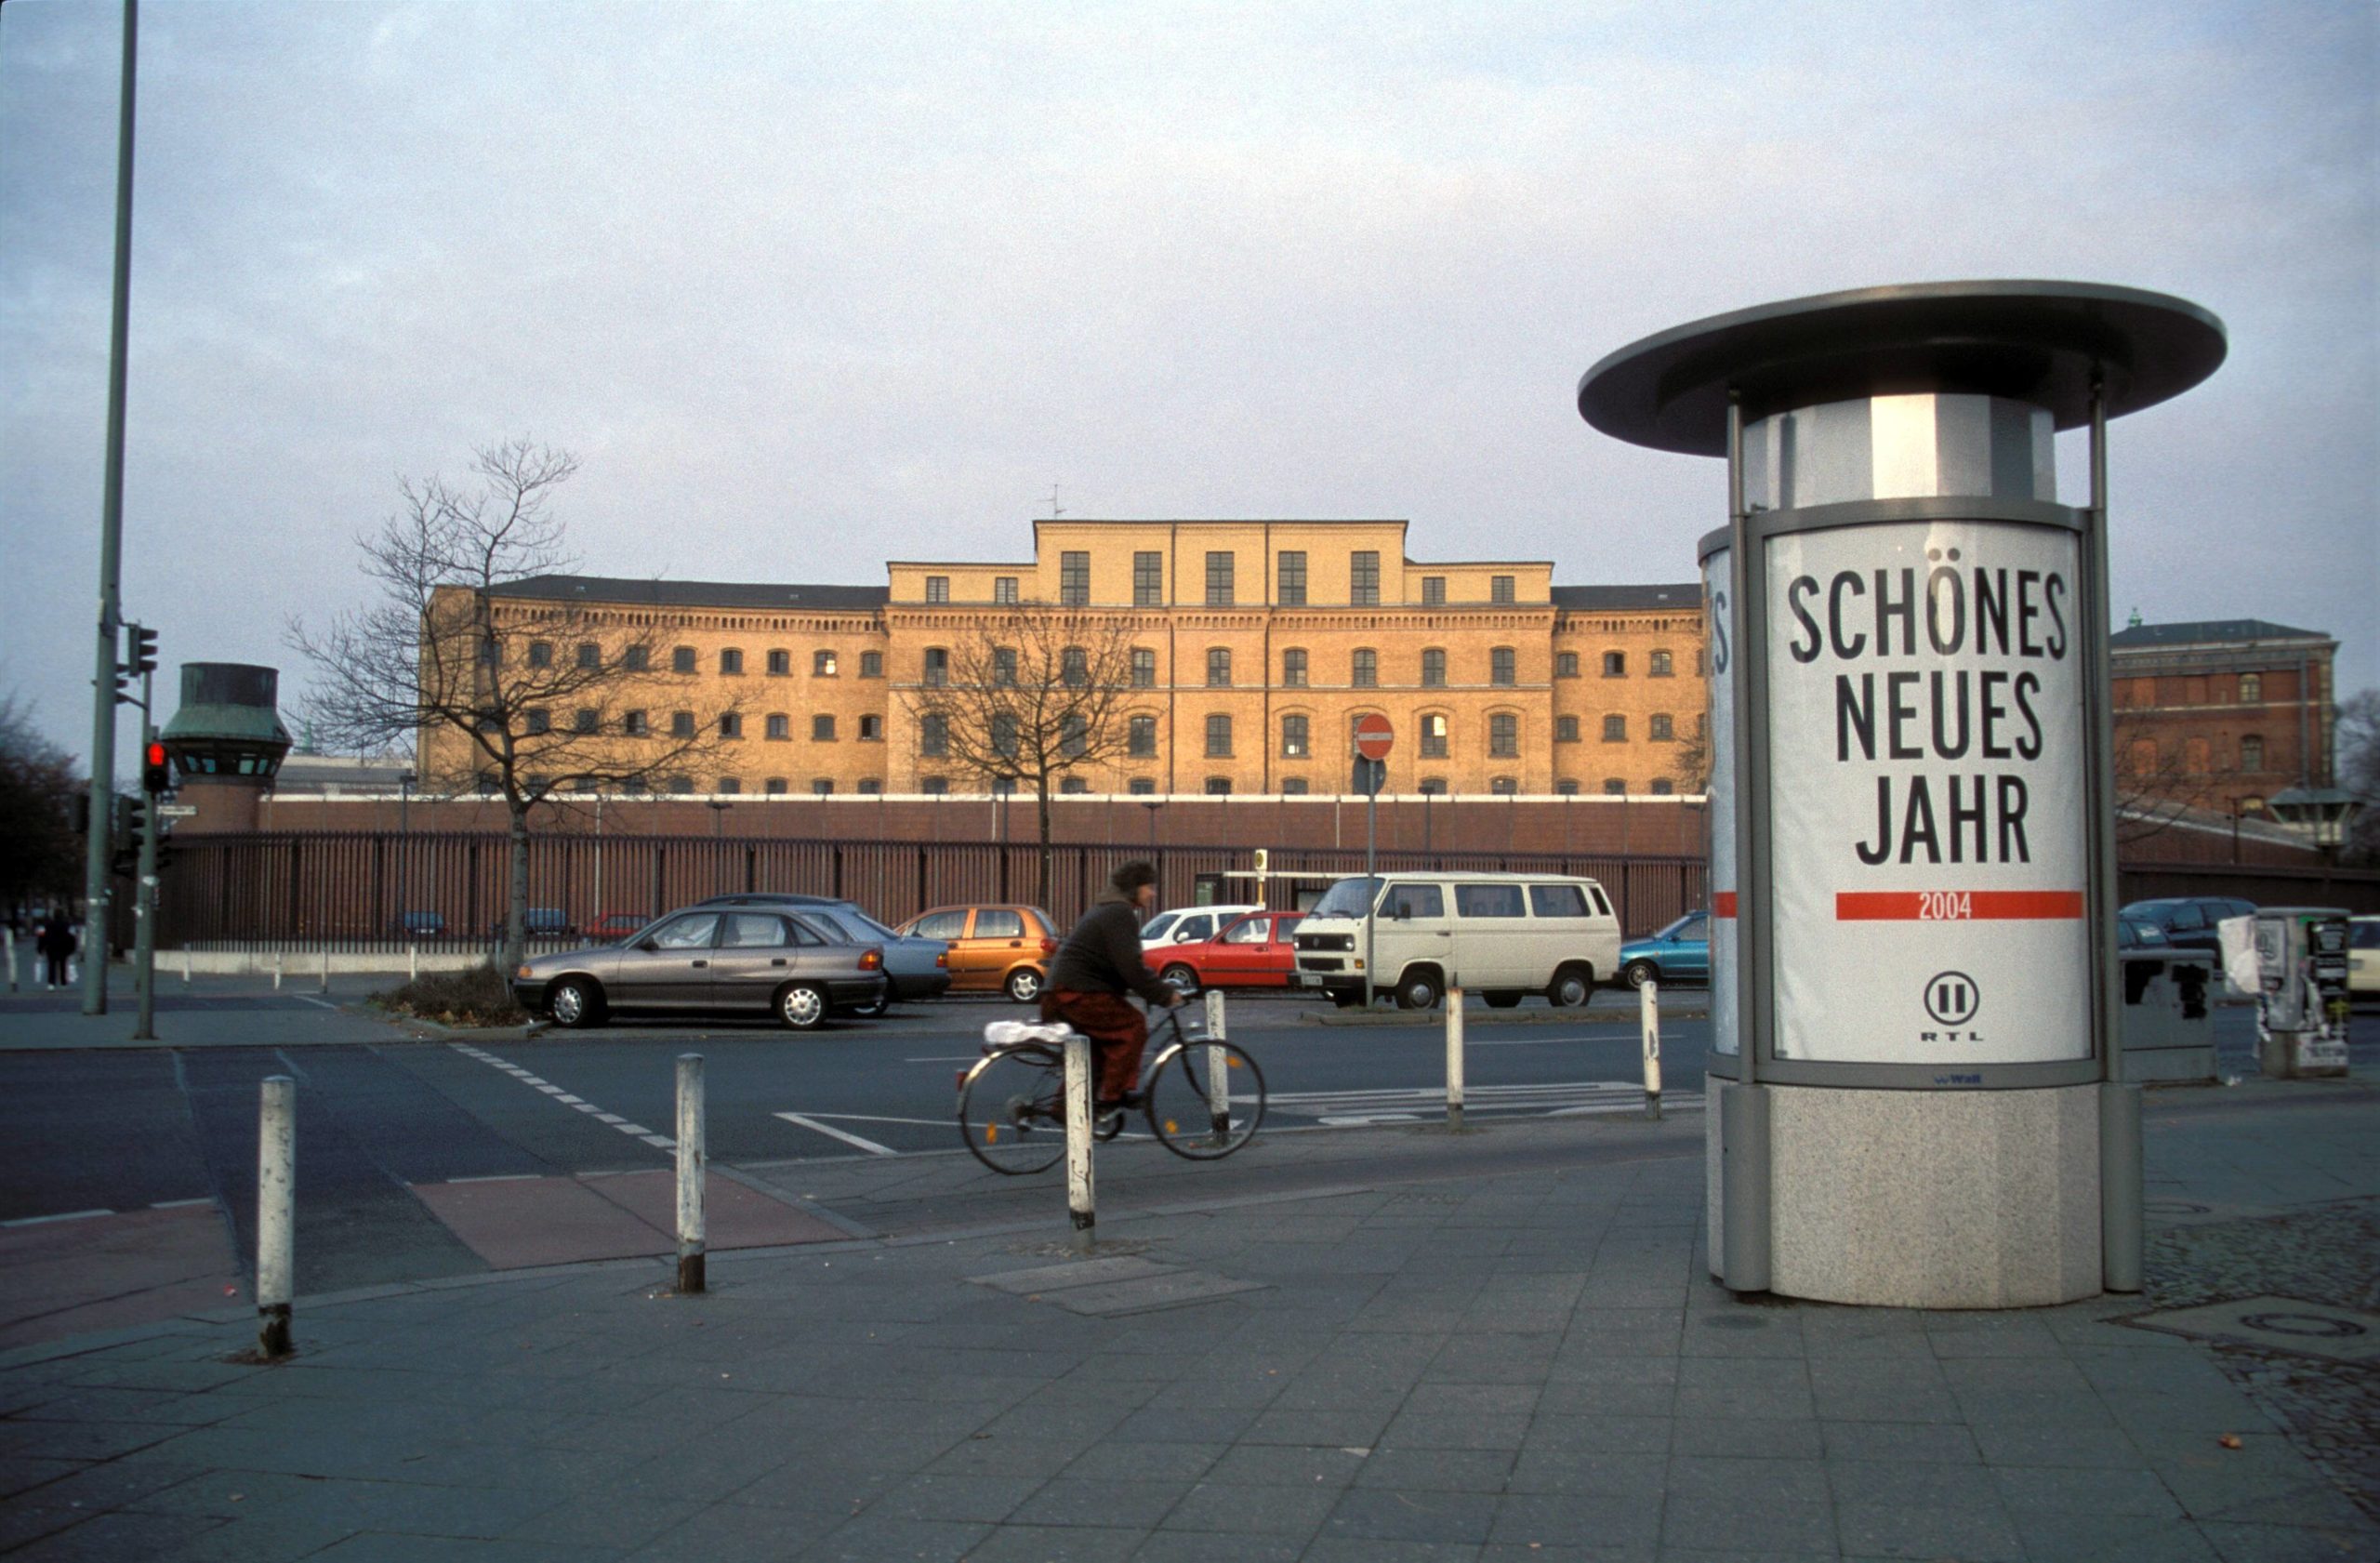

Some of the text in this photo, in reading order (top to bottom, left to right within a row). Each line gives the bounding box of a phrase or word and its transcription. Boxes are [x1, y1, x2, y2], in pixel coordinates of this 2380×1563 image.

[1788, 548, 2068, 663] SCHÖNES
[1836, 670, 2043, 762] NEUES
[1856, 775, 2031, 866] JAHR
[1918, 891, 1972, 921] 2004
[1920, 1031, 1984, 1042] RTL
